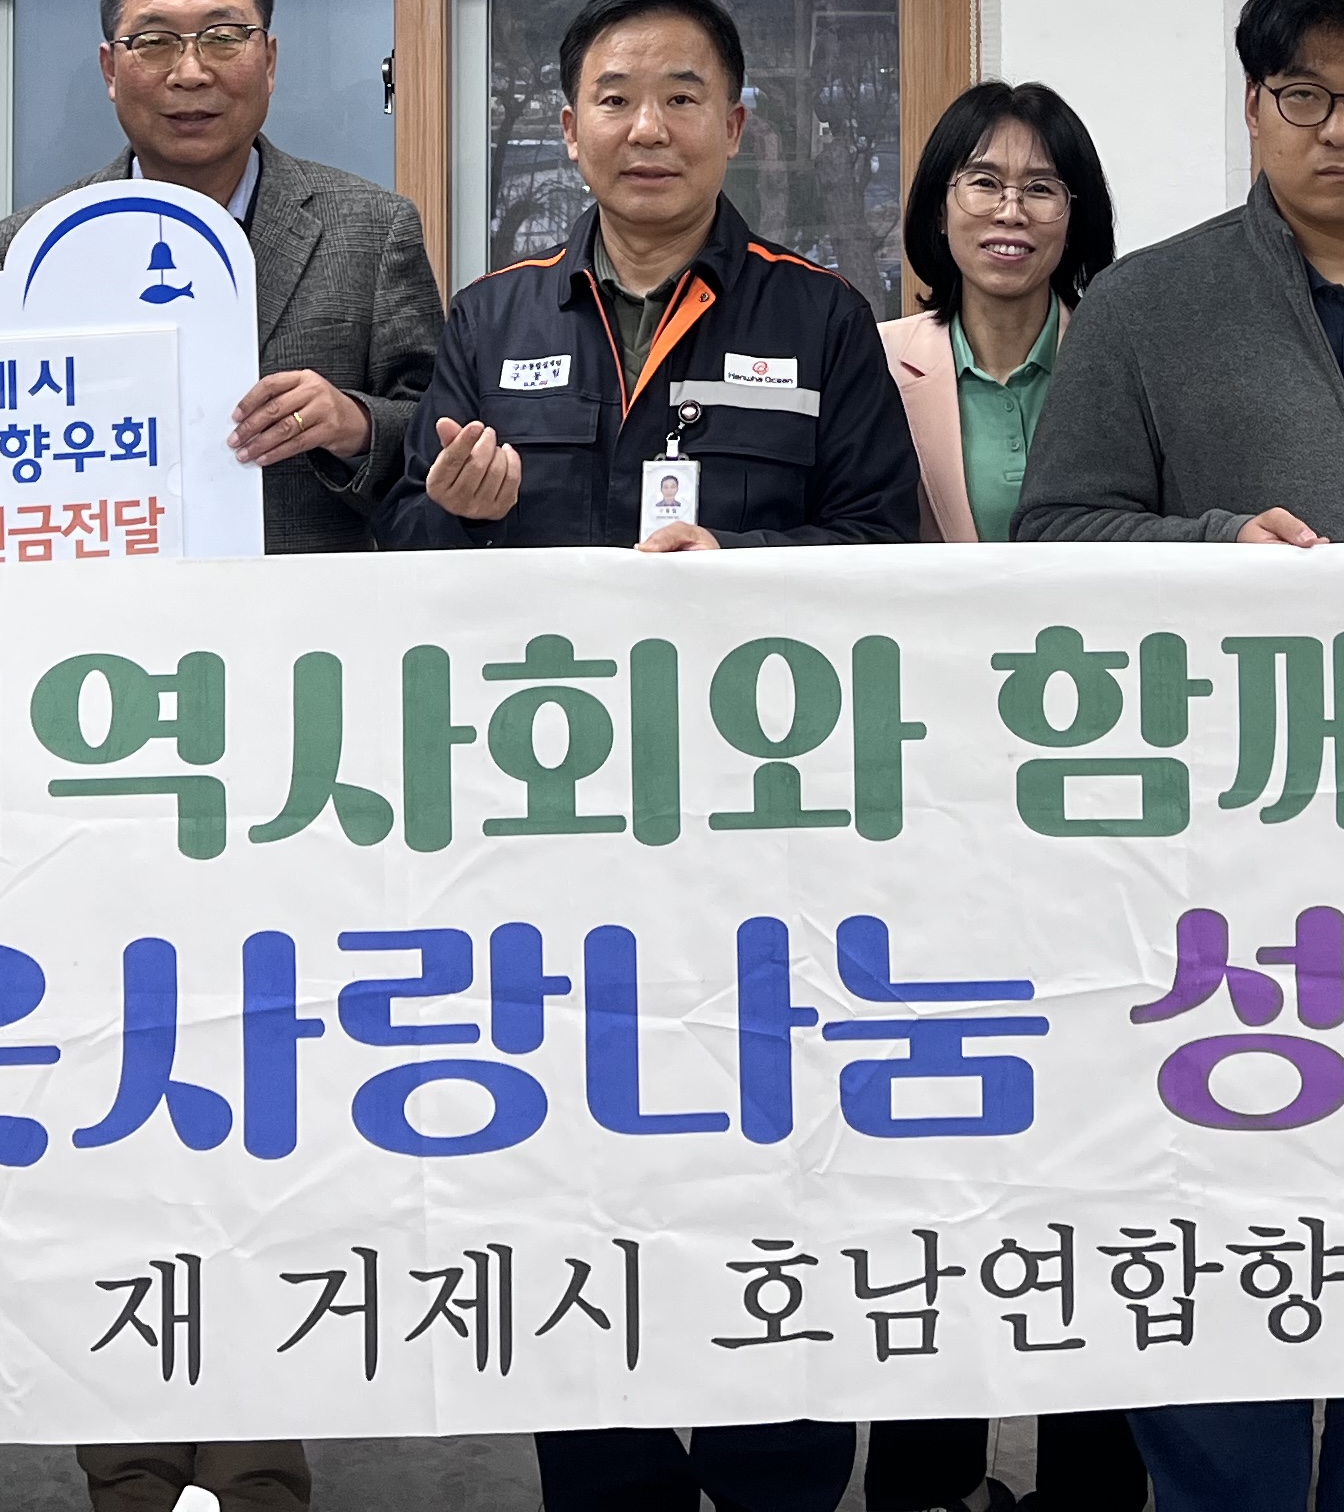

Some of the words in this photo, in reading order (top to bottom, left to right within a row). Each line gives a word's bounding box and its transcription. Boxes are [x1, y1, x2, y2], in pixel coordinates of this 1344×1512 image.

[728, 372, 763, 383] Hanwha
[764, 376, 794, 385] Ocean
[91, 1254, 201, 1385] 재
[277, 1239, 639, 1381] 거제시
